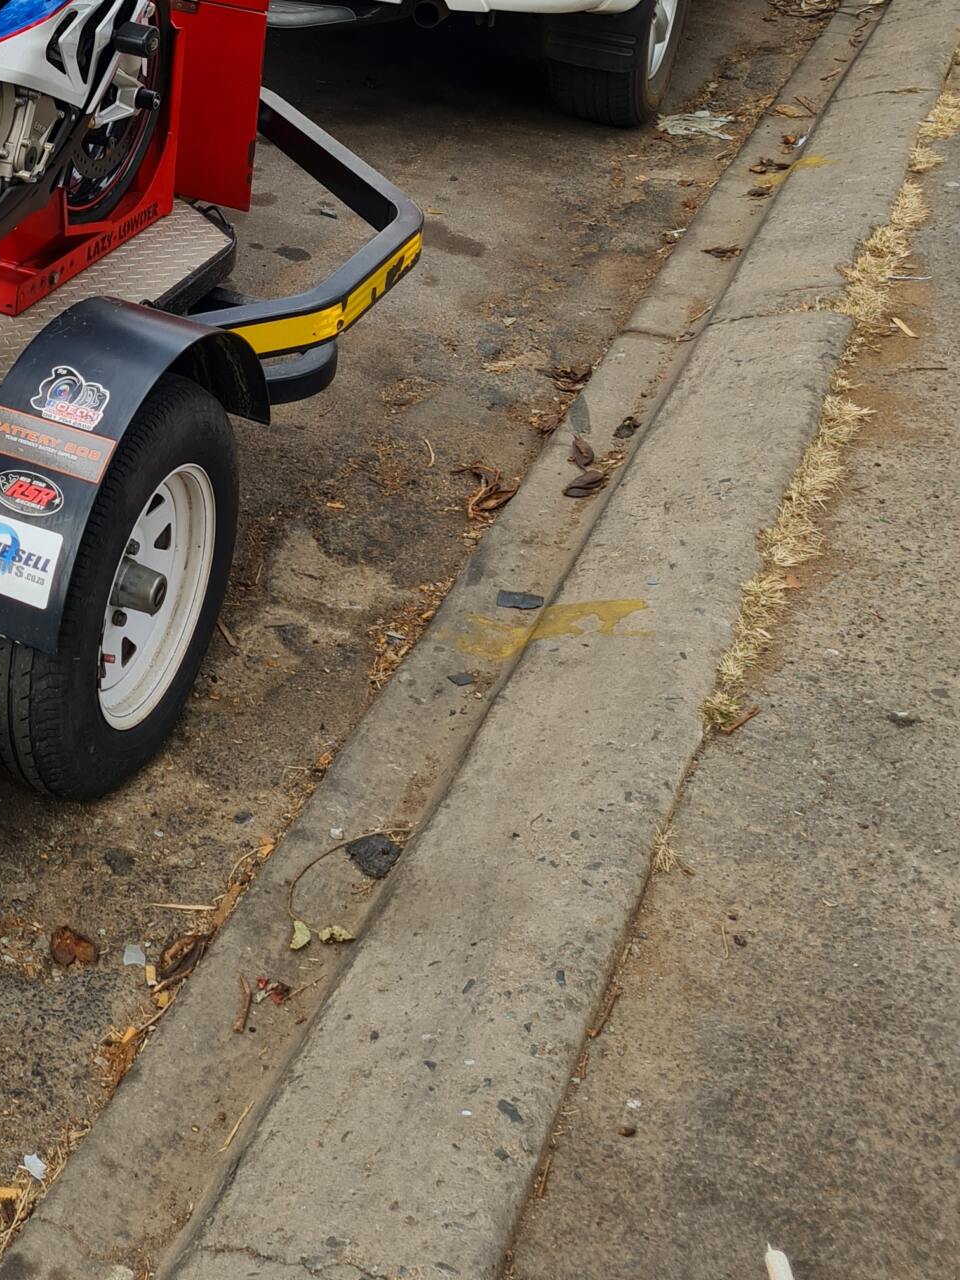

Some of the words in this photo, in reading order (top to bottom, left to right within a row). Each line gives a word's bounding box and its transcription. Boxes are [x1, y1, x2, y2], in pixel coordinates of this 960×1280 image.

[64, 441, 101, 463] BOB
[5, 480, 56, 507] RSR
[11, 548, 51, 573] SELL
